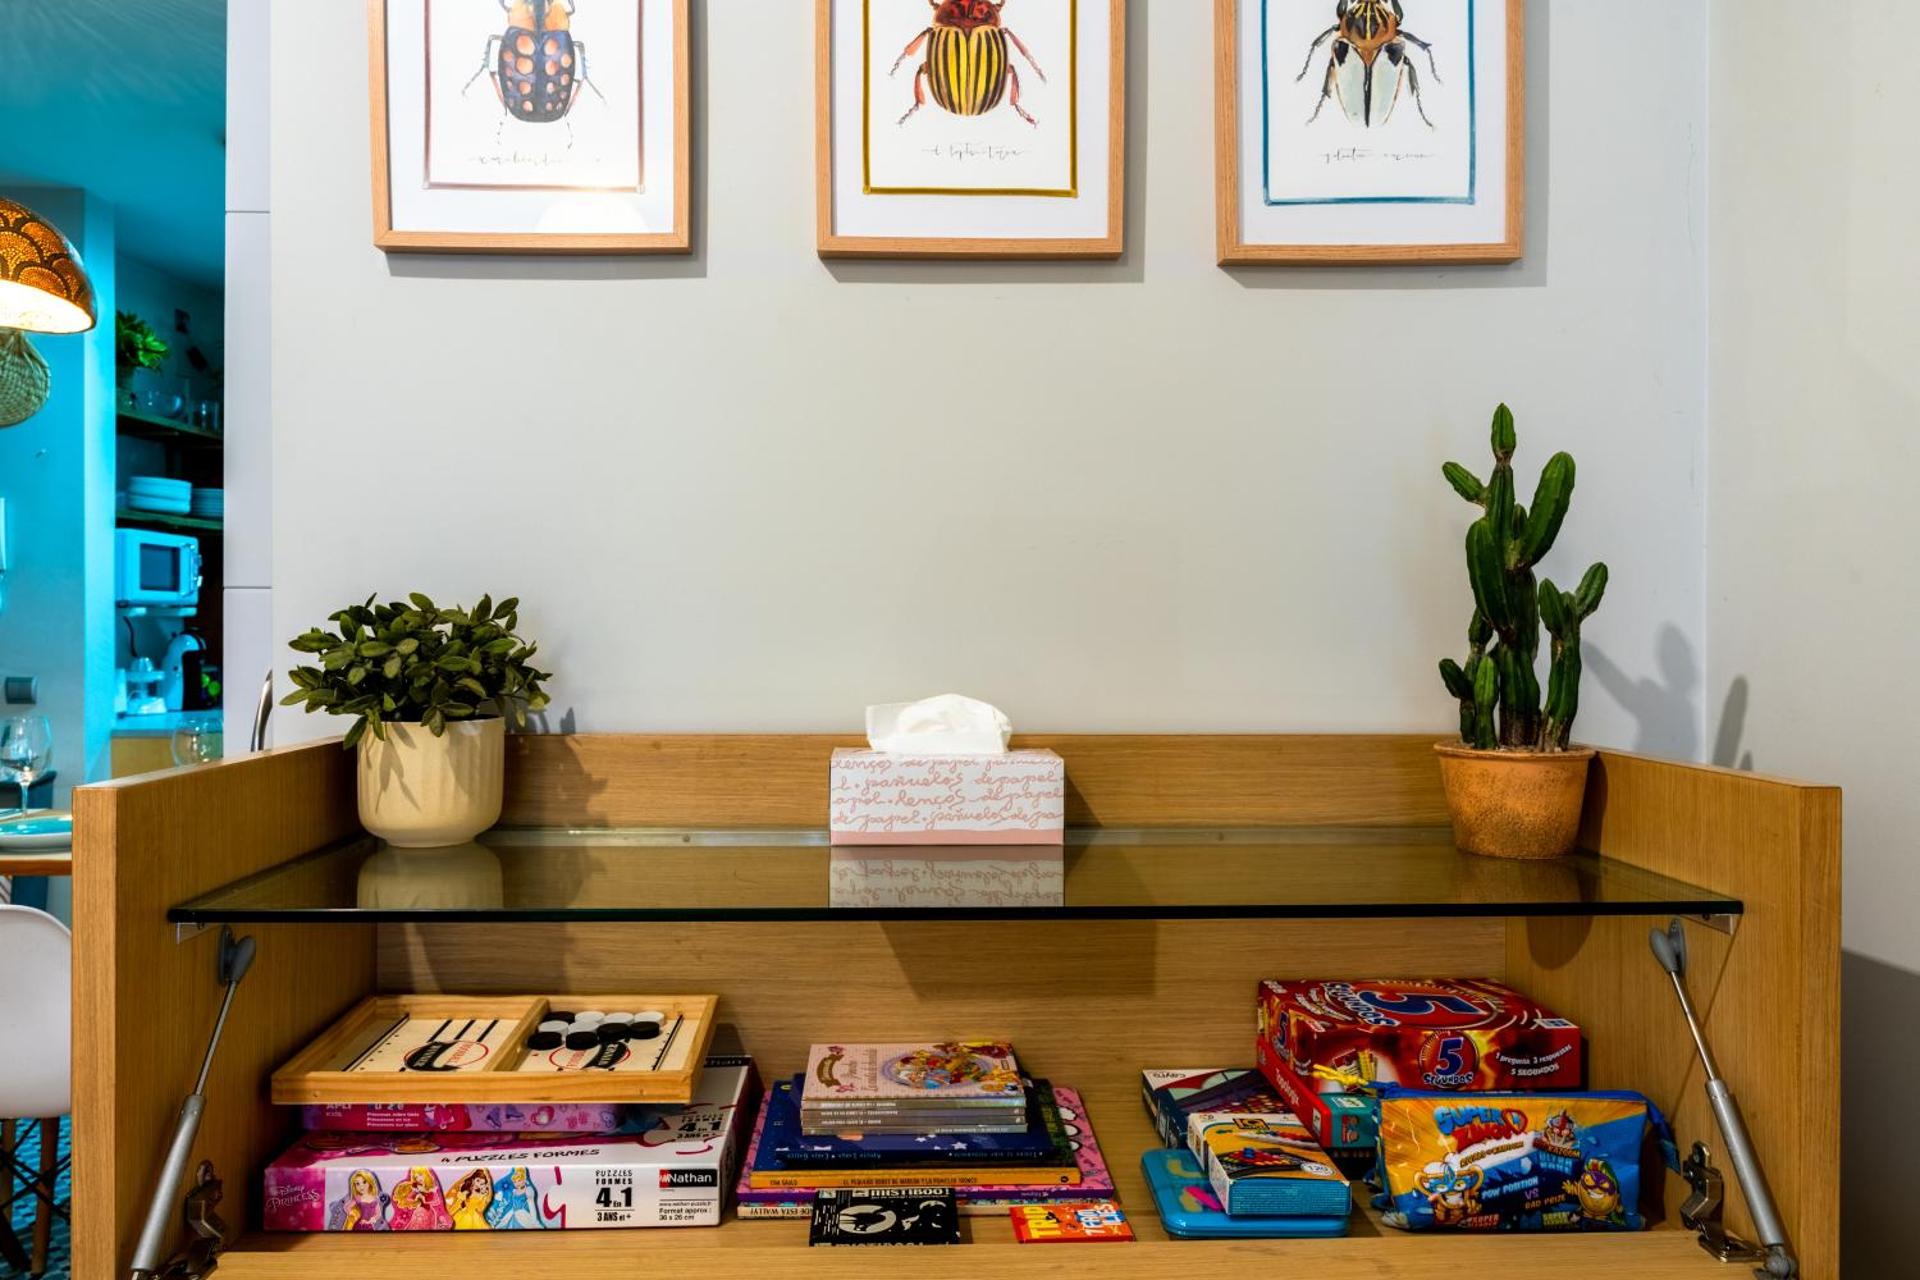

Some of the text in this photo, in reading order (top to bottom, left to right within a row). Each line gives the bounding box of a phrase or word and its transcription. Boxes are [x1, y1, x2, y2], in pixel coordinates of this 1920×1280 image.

[1434, 1036, 1465, 1076] 5
[1516, 1063, 1560, 1077] SEGUNDOS
[1422, 1071, 1474, 1085] SEGUNDOS
[1433, 1105, 1504, 1135] SUPER
[455, 1152, 530, 1163] PUZZLES
[533, 1148, 600, 1159] FORMES
[595, 1169, 633, 1177] PUZZLES
[667, 1173, 713, 1184] Nathan
[1481, 1176, 1539, 1200] POW POSITION
[1524, 1188, 1540, 1201] VS
[595, 1187, 612, 1208] 4
[621, 1187, 633, 1208] 1
[597, 1212, 603, 1221] 3
[603, 1212, 618, 1221] ANS
